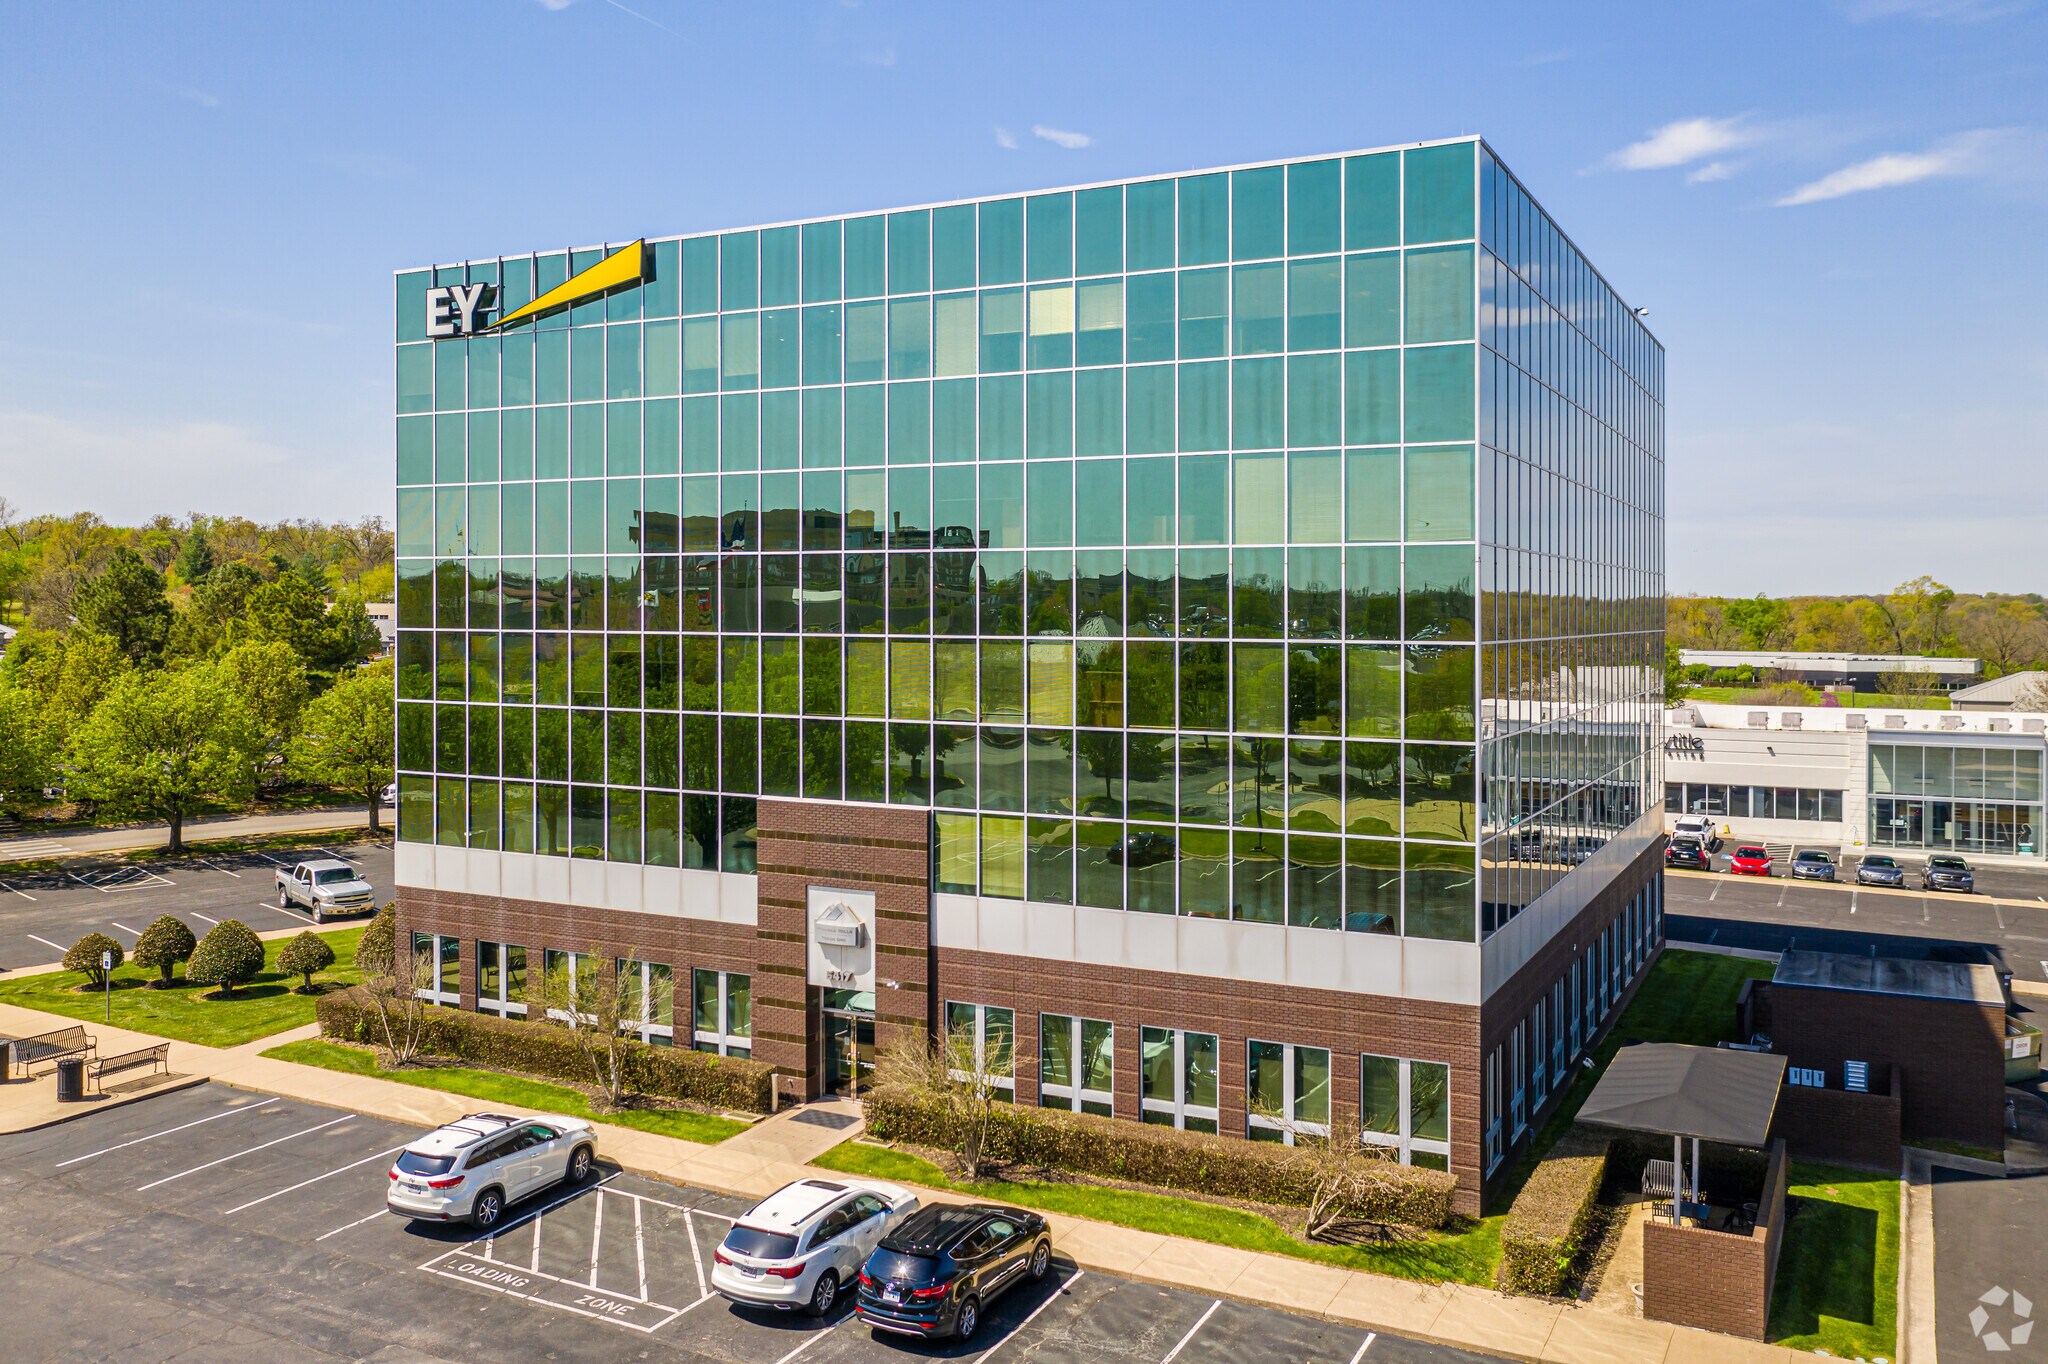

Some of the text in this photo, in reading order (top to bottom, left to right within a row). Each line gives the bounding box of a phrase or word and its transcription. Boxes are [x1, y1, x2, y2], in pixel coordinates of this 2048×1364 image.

[426, 282, 488, 337] EY
[446, 1259, 635, 1315] LOADING ZONE
